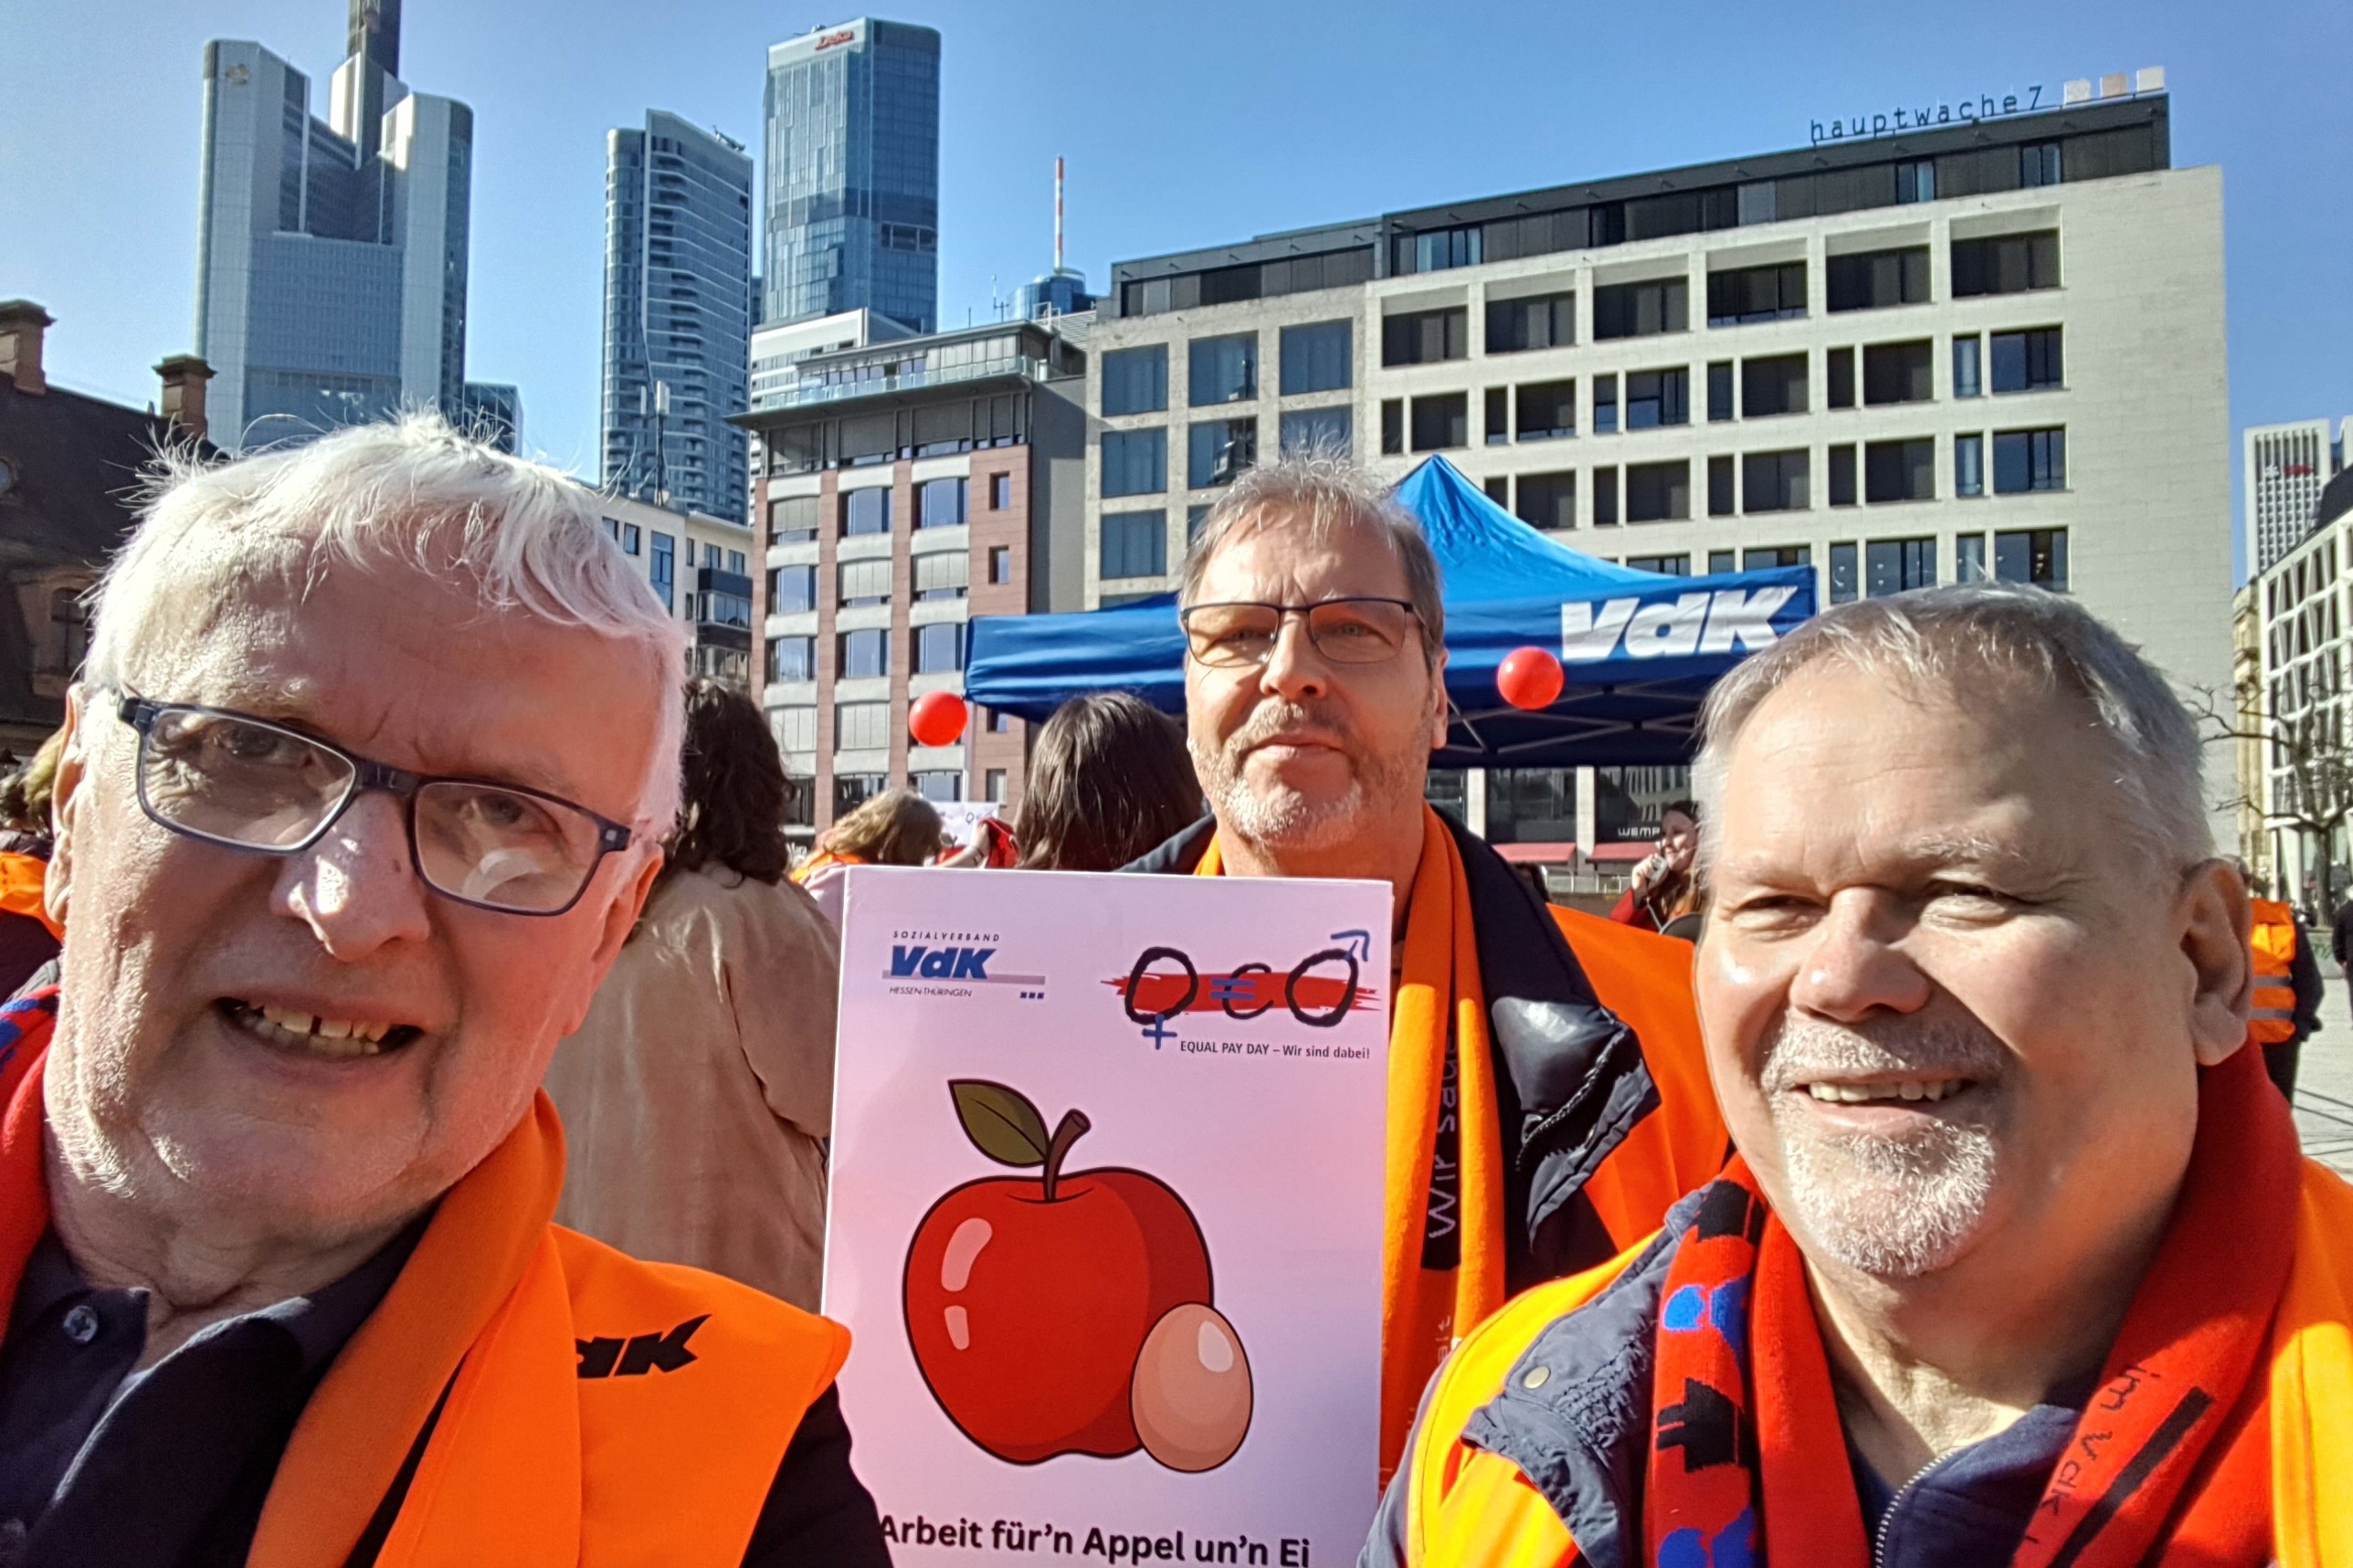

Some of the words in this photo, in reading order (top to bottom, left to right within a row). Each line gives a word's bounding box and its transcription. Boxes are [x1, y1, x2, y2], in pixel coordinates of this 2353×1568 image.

[1561, 585, 1798, 660] VdK
[892, 931, 1000, 942] SOZIALVERBAND
[891, 945, 997, 980] VdK
[1180, 1040, 1218, 1054] EQUAL
[1222, 1042, 1243, 1055] PAY
[1247, 1043, 1271, 1056] DAY
[1282, 1044, 1303, 1057] Wir
[1305, 1046, 1330, 1058] sind
[1334, 1046, 1370, 1059] dabei!
[1428, 1153, 1457, 1239] Wir
[880, 1515, 983, 1549] Arbeit
[1082, 1528, 1185, 1565] Appel
[1280, 1538, 1310, 1568] Ei
